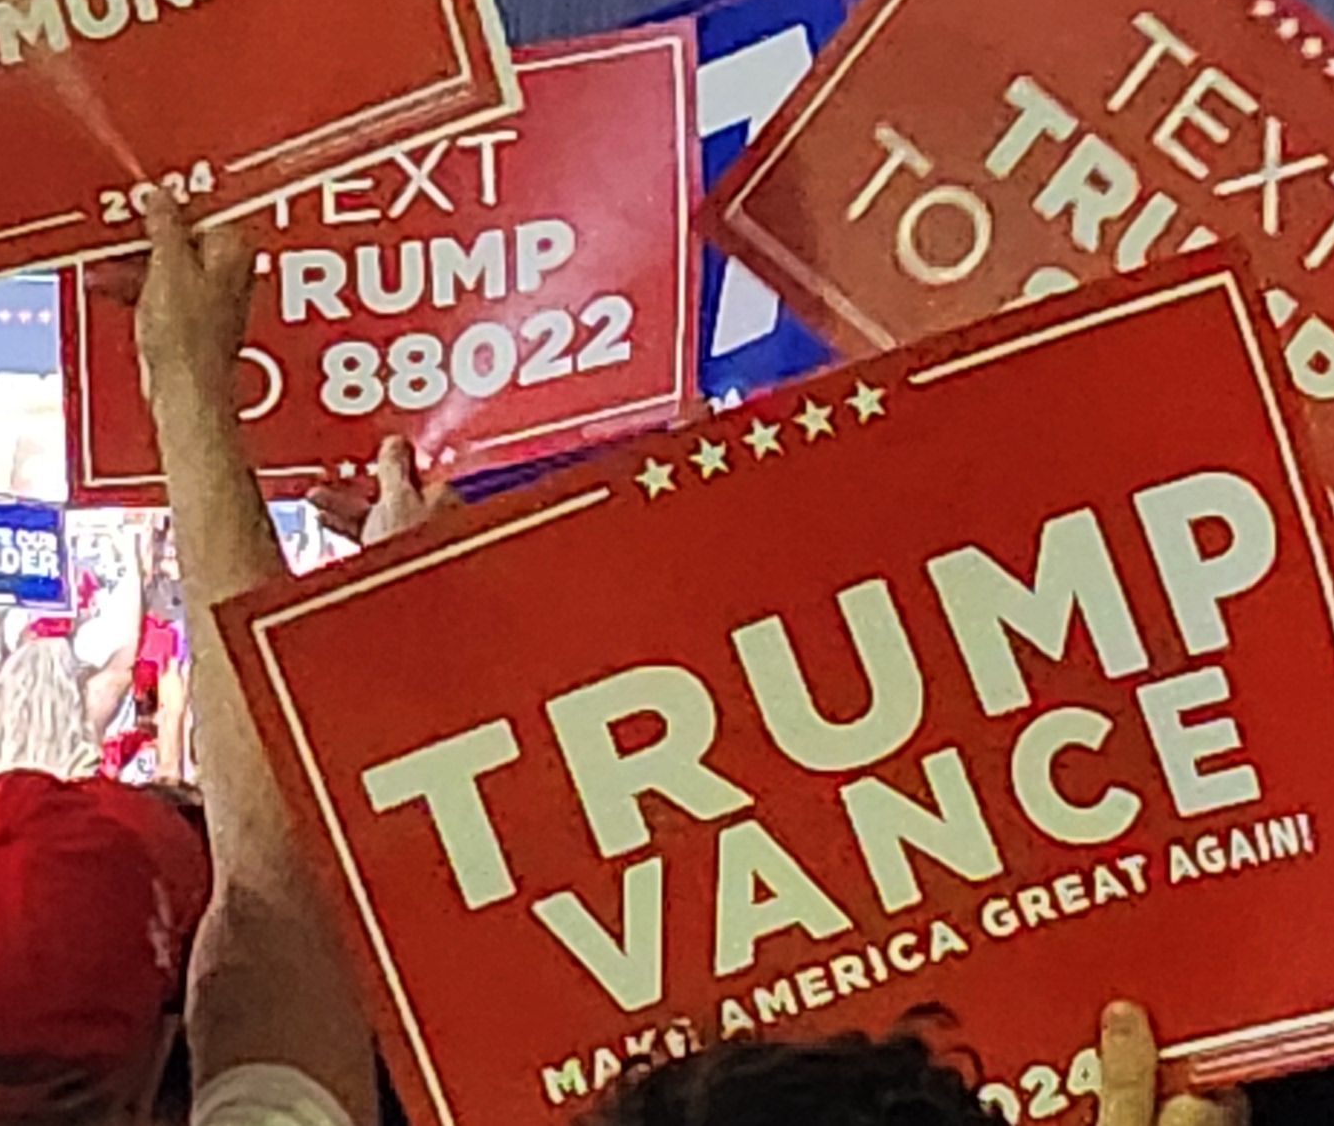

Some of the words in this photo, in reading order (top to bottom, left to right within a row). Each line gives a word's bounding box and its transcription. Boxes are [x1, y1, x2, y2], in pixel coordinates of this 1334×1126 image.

[254, 219, 576, 322] RUMP
[847, 122, 991, 285] TO
[320, 296, 633, 415] 88022
[360, 472, 1277, 914] TRUMP
[533, 665, 1262, 1012] VANCE
[720, 921, 968, 1040] AMERICA
[981, 854, 1147, 937] GREAT
[1169, 814, 1314, 884] AGAIN!
